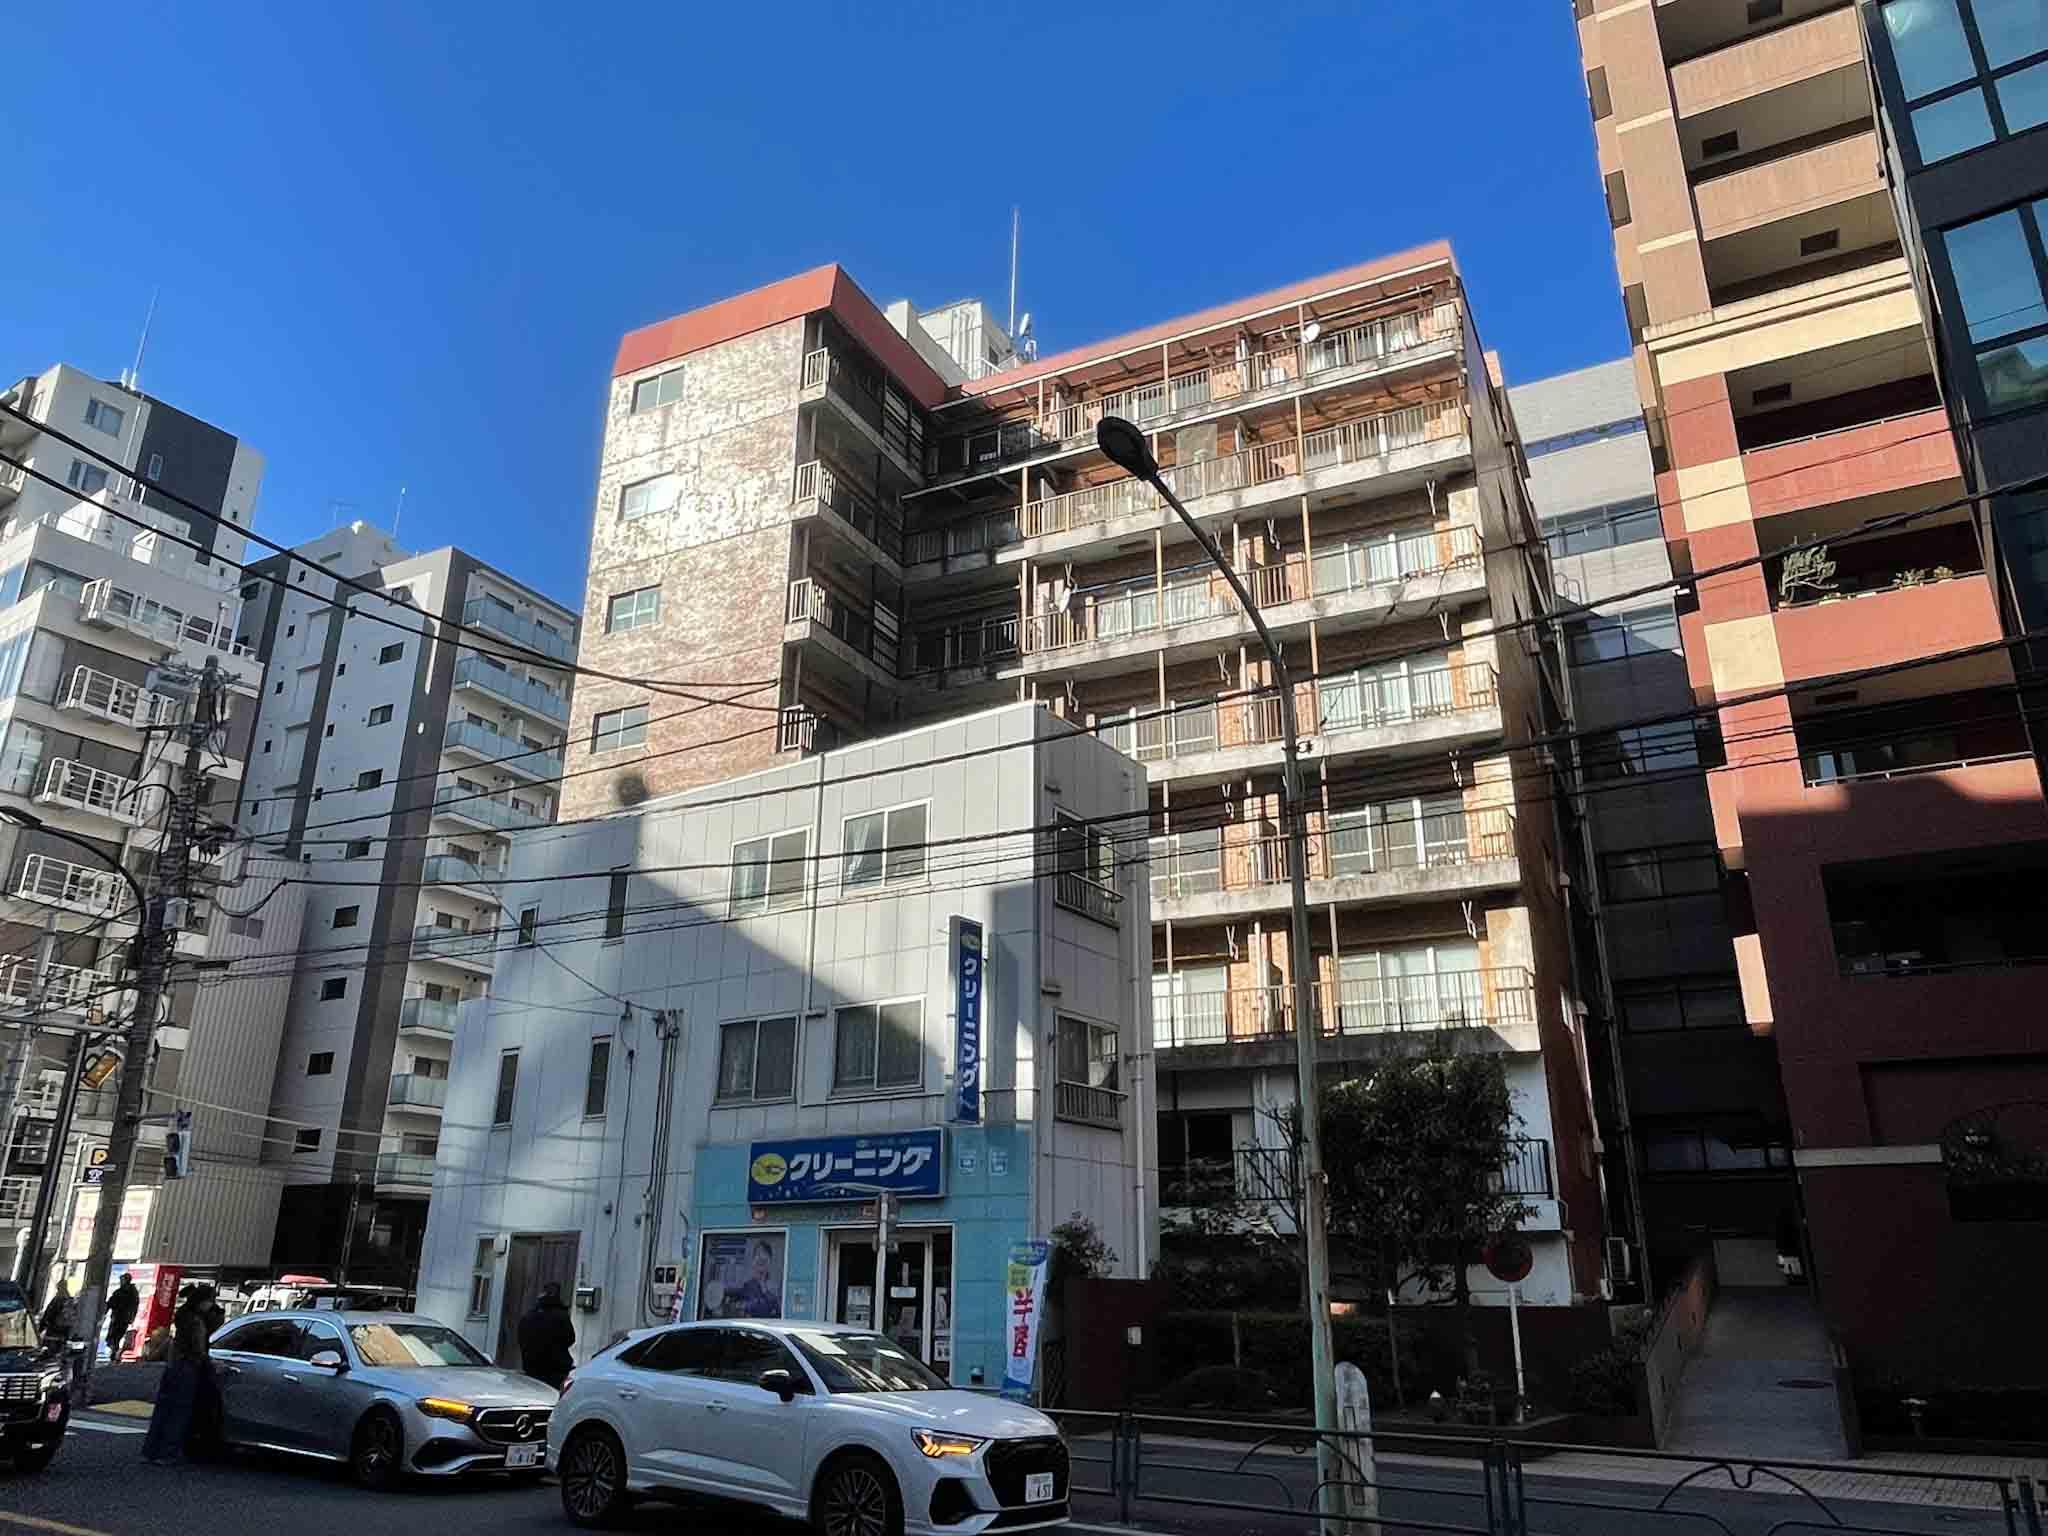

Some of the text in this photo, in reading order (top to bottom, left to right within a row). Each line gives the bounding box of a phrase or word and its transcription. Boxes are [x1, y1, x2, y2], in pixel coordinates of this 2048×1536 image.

[963, 958, 980, 1088] クリーニング
[789, 1146, 932, 1182] クリーニング
